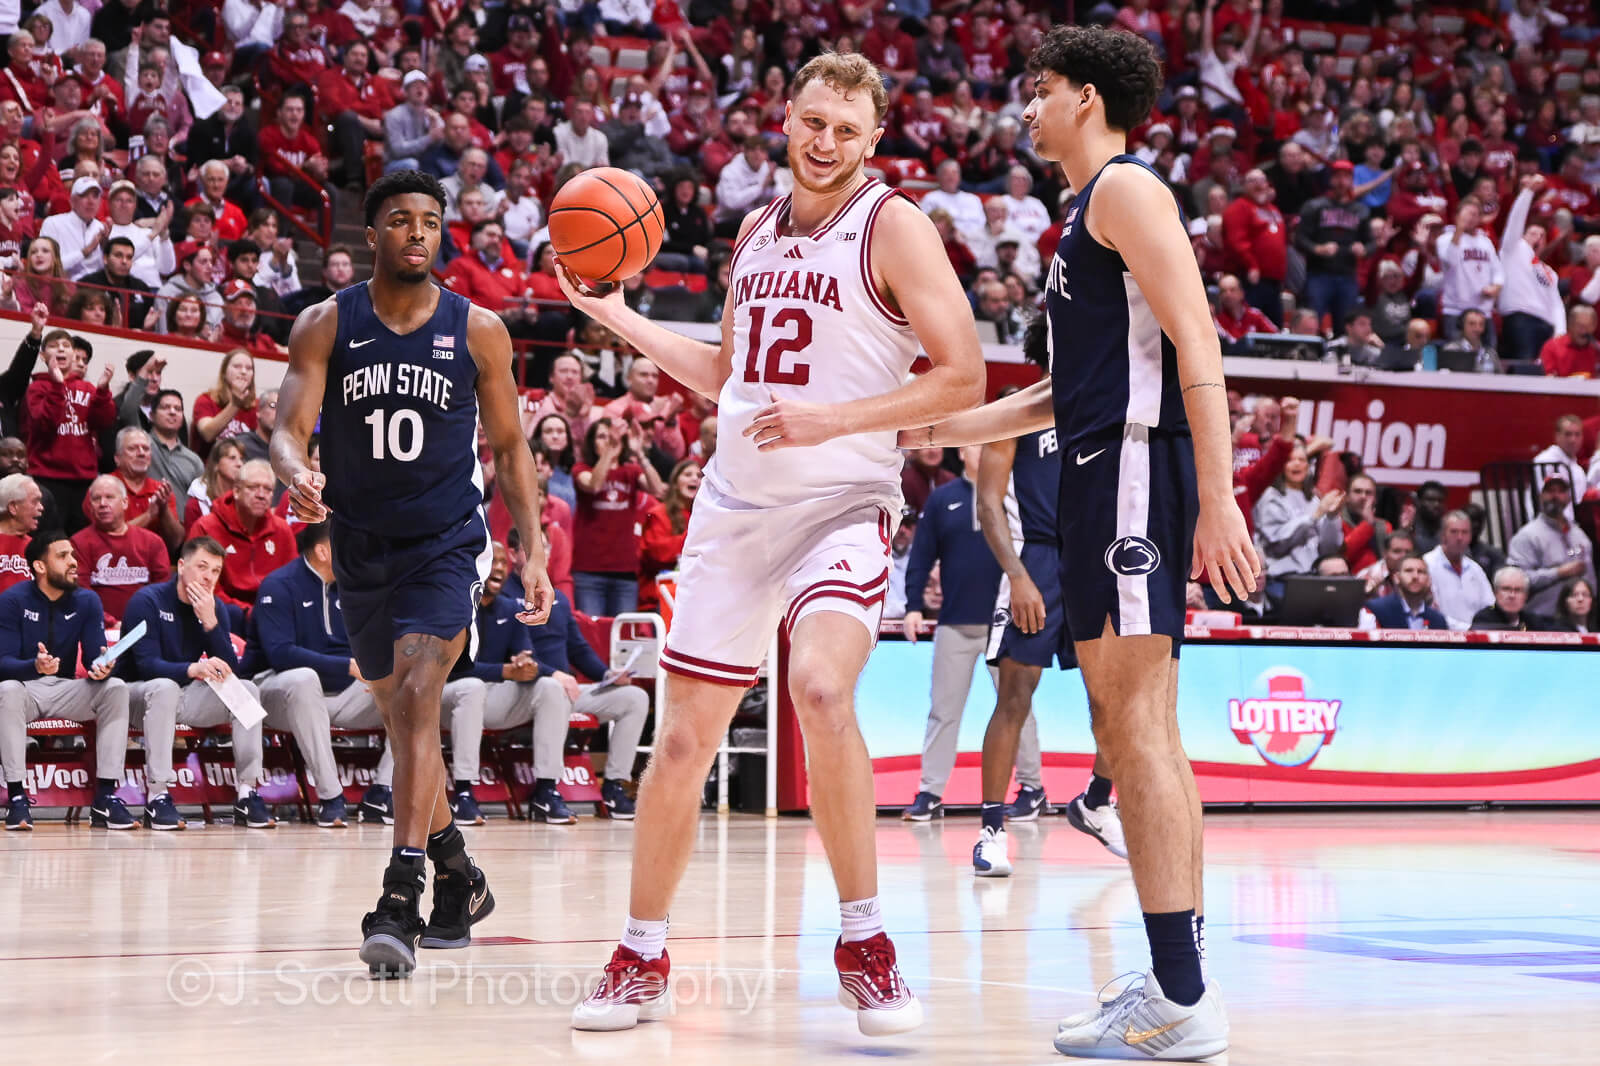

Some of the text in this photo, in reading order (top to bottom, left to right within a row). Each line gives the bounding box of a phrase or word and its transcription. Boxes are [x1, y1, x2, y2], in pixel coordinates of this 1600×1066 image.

[734, 270, 844, 313] INDIANA
[1044, 252, 1072, 300] ATE
[743, 306, 813, 386] 12
[342, 363, 453, 411] PENN STATE
[364, 408, 425, 462] 10
[1296, 399, 1447, 469] Union
[1229, 699, 1342, 733] LOTTERY
